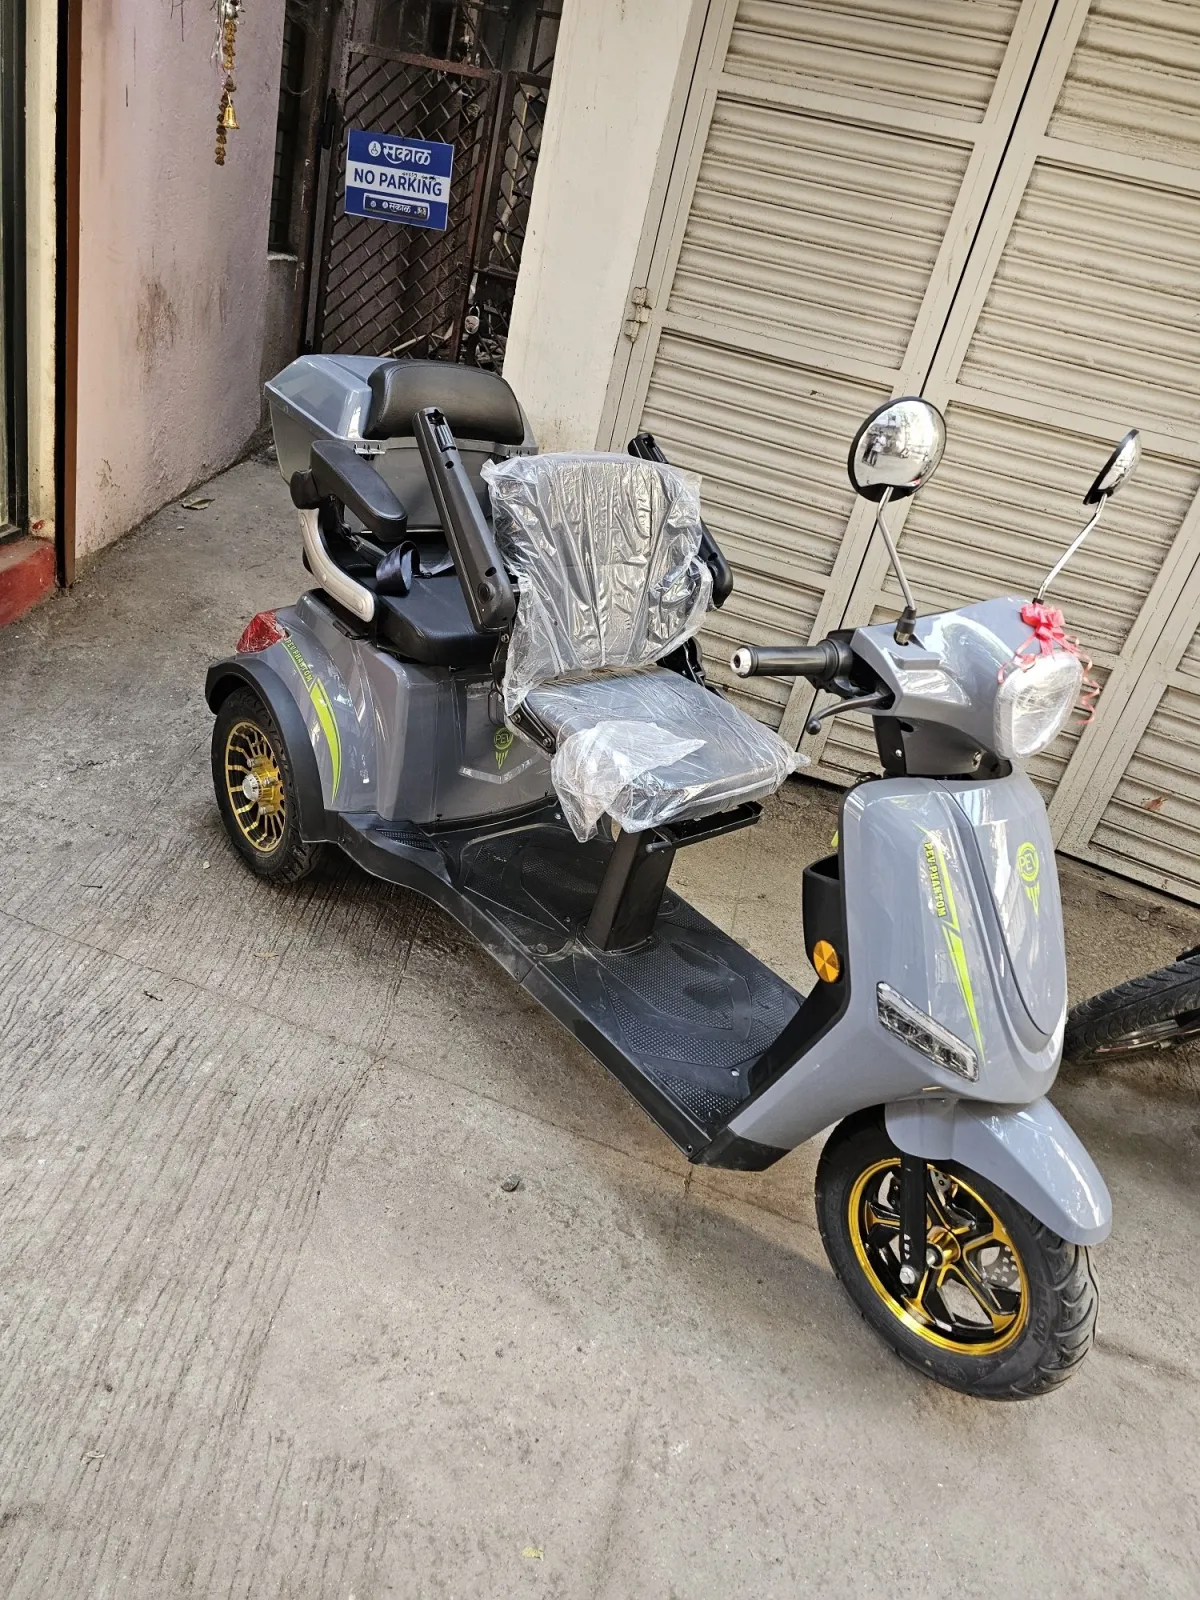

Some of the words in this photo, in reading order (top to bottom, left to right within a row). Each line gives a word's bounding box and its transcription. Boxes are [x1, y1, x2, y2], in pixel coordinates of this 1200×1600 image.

[382, 142, 432, 166] सकाळ
[354, 168, 375, 184] NO
[379, 173, 442, 196] PARKING
[292, 649, 313, 682] PHANTOM
[924, 842, 936, 863] PEV
[928, 864, 947, 917] PHANTOM
